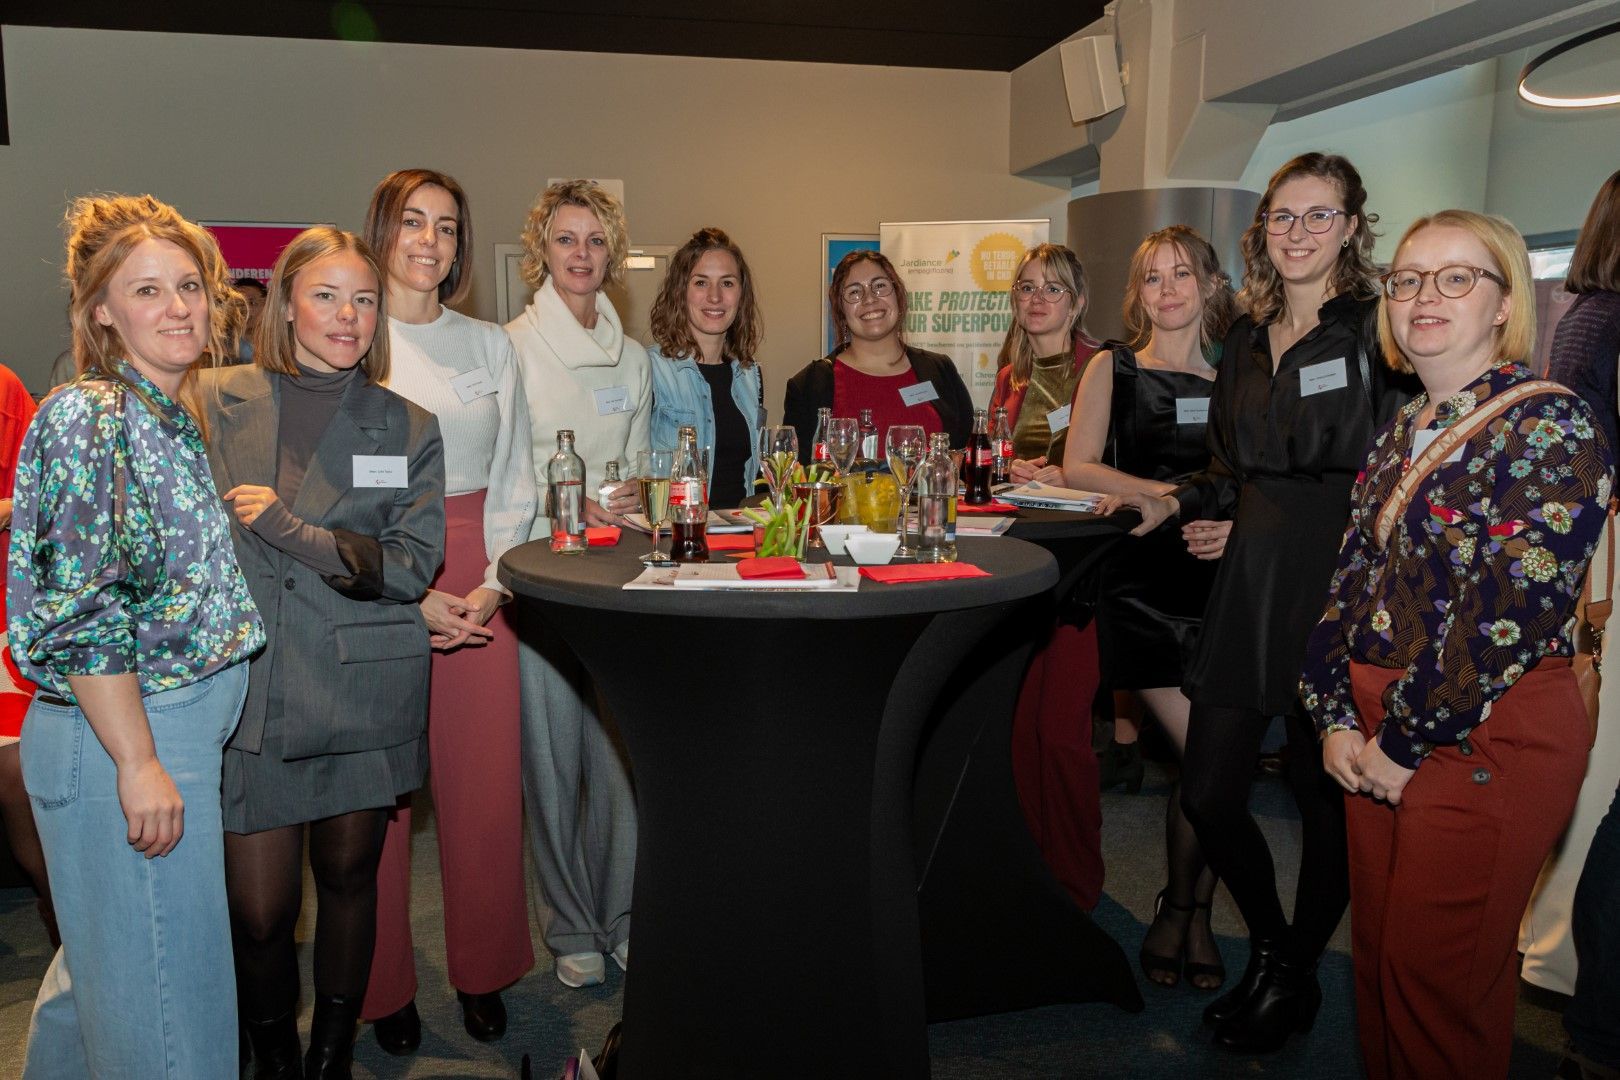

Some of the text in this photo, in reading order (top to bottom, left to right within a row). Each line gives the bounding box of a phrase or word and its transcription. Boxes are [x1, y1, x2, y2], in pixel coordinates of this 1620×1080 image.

[900, 258, 943, 268] Jardiance
[228, 268, 273, 279] NDEREN
[938, 290, 1010, 311] PROTECTI
[931, 313, 1012, 333] SUPERPOW
